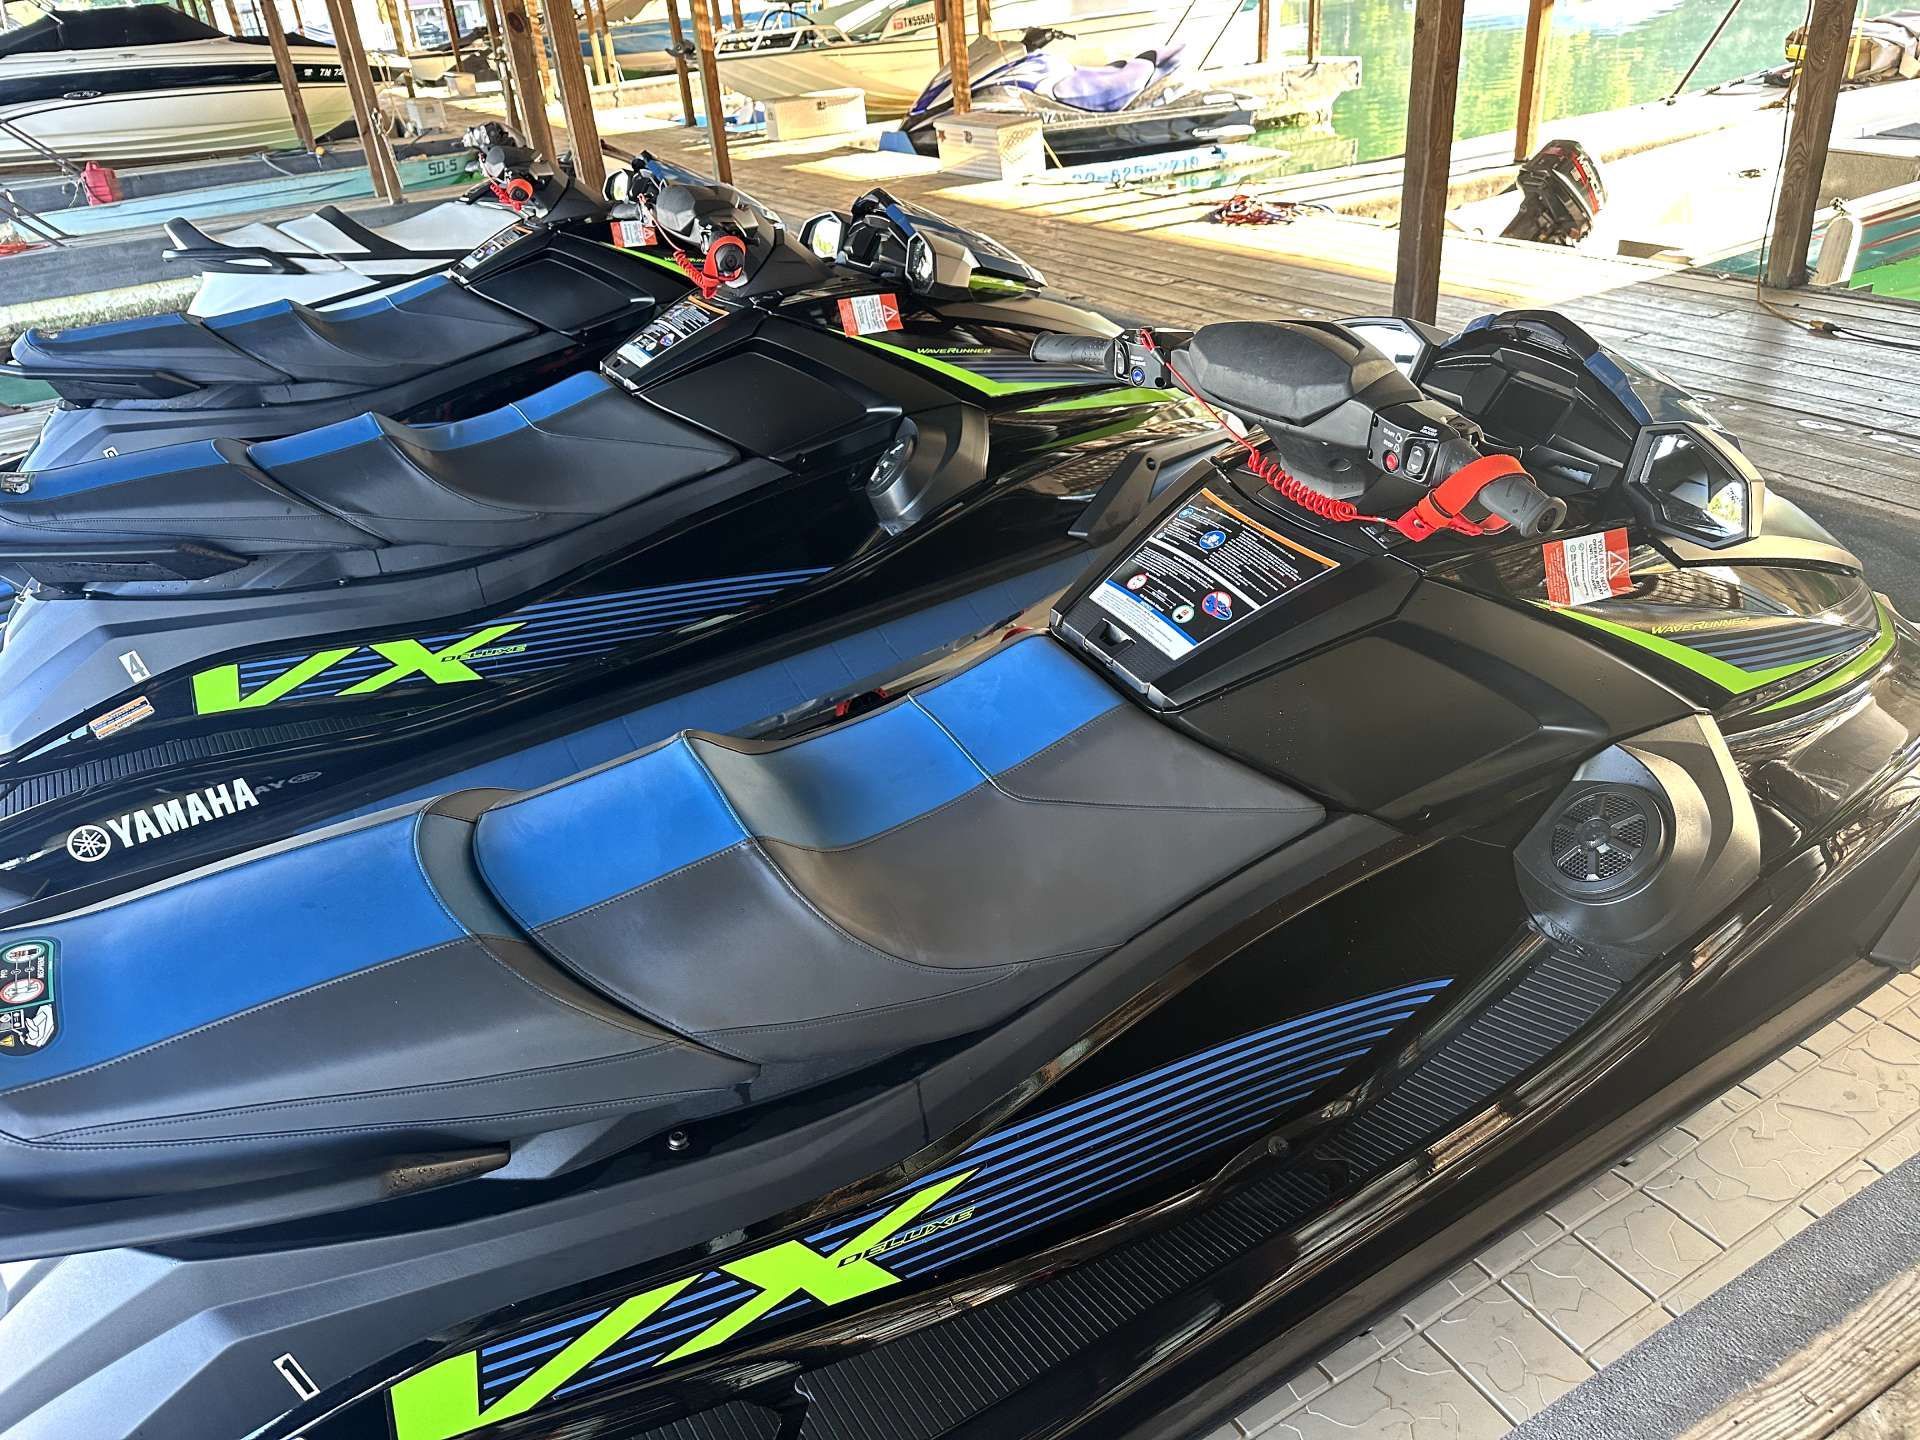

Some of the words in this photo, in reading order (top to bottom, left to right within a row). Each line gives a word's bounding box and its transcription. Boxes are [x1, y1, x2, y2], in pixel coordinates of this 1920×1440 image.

[129, 653, 146, 677] 4
[192, 621, 526, 715] VX
[106, 777, 259, 849] YAMAHA
[837, 1206, 976, 1269] DELUXE
[390, 1167, 980, 1440] VX
[281, 1358, 315, 1395] 1
